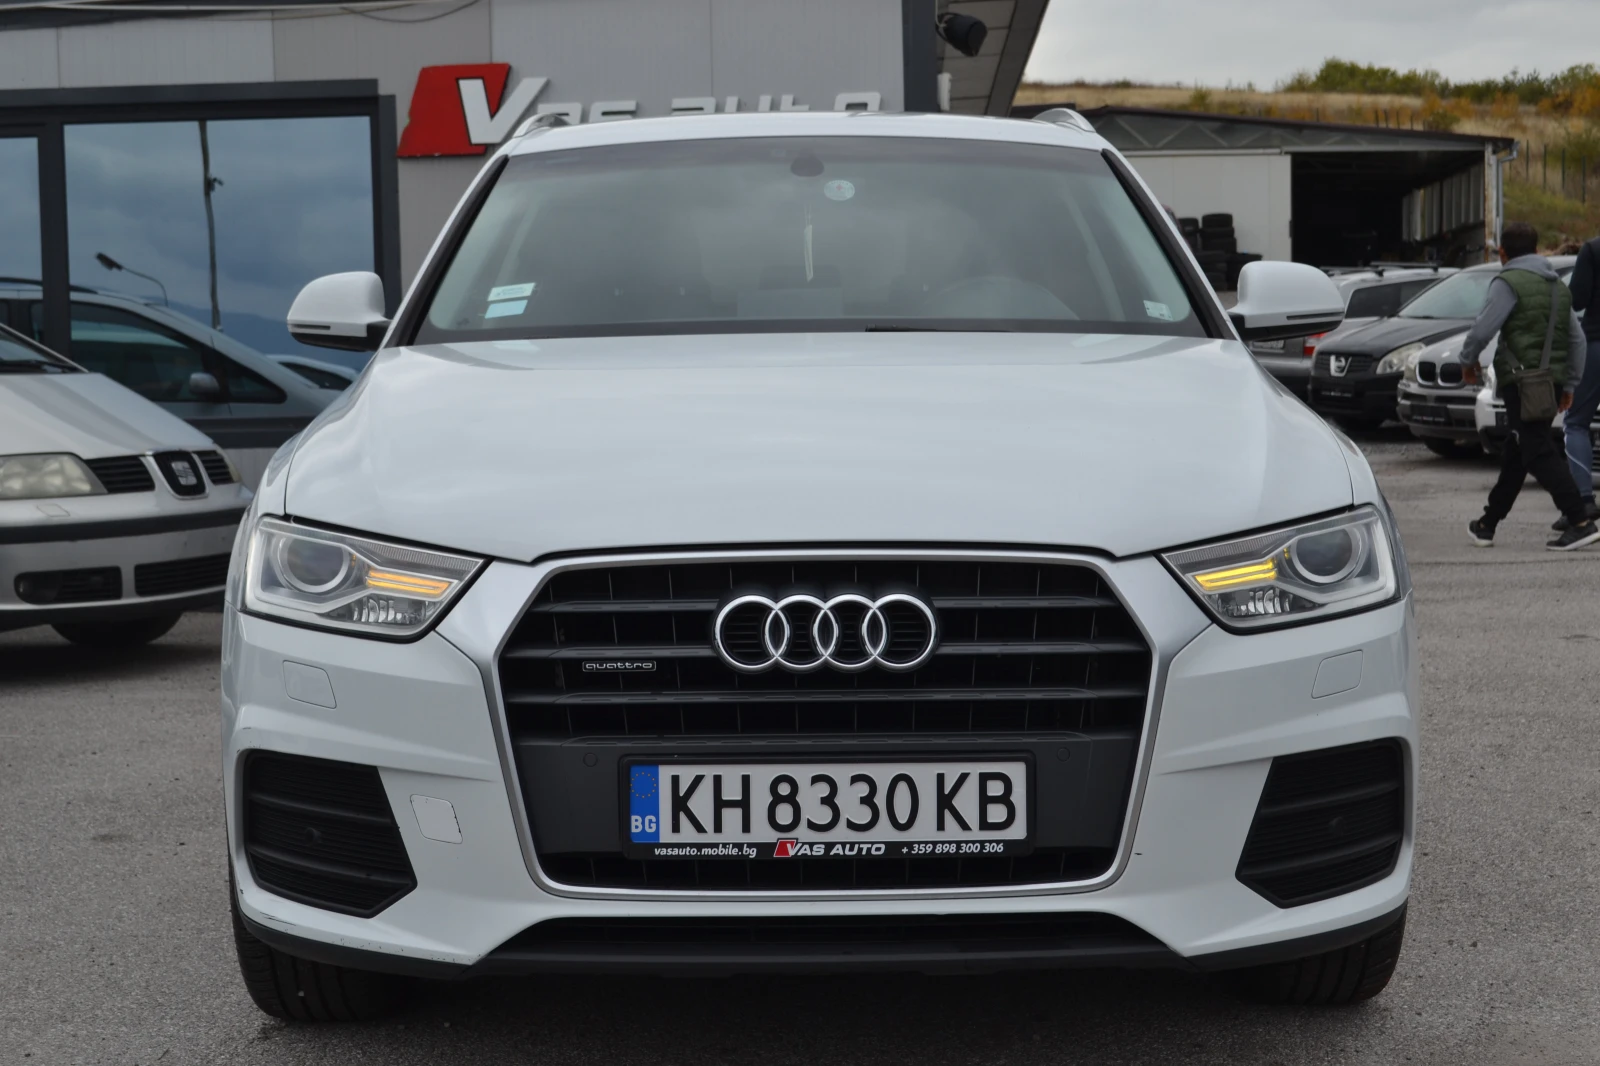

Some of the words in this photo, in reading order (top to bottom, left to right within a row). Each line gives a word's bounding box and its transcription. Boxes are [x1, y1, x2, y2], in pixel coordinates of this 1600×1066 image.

[586, 662, 653, 671] quattro
[671, 773, 751, 834] KH
[767, 772, 919, 833] 8330
[936, 771, 1016, 832] KB
[631, 815, 657, 833] BG
[654, 844, 757, 858] vasauto.mobile.bg
[786, 843, 825, 857] VAS
[830, 843, 886, 856] AUTO
[911, 843, 934, 854] 359
[935, 843, 957, 854] 898
[959, 842, 981, 854] 300
[983, 842, 1004, 853] 306
